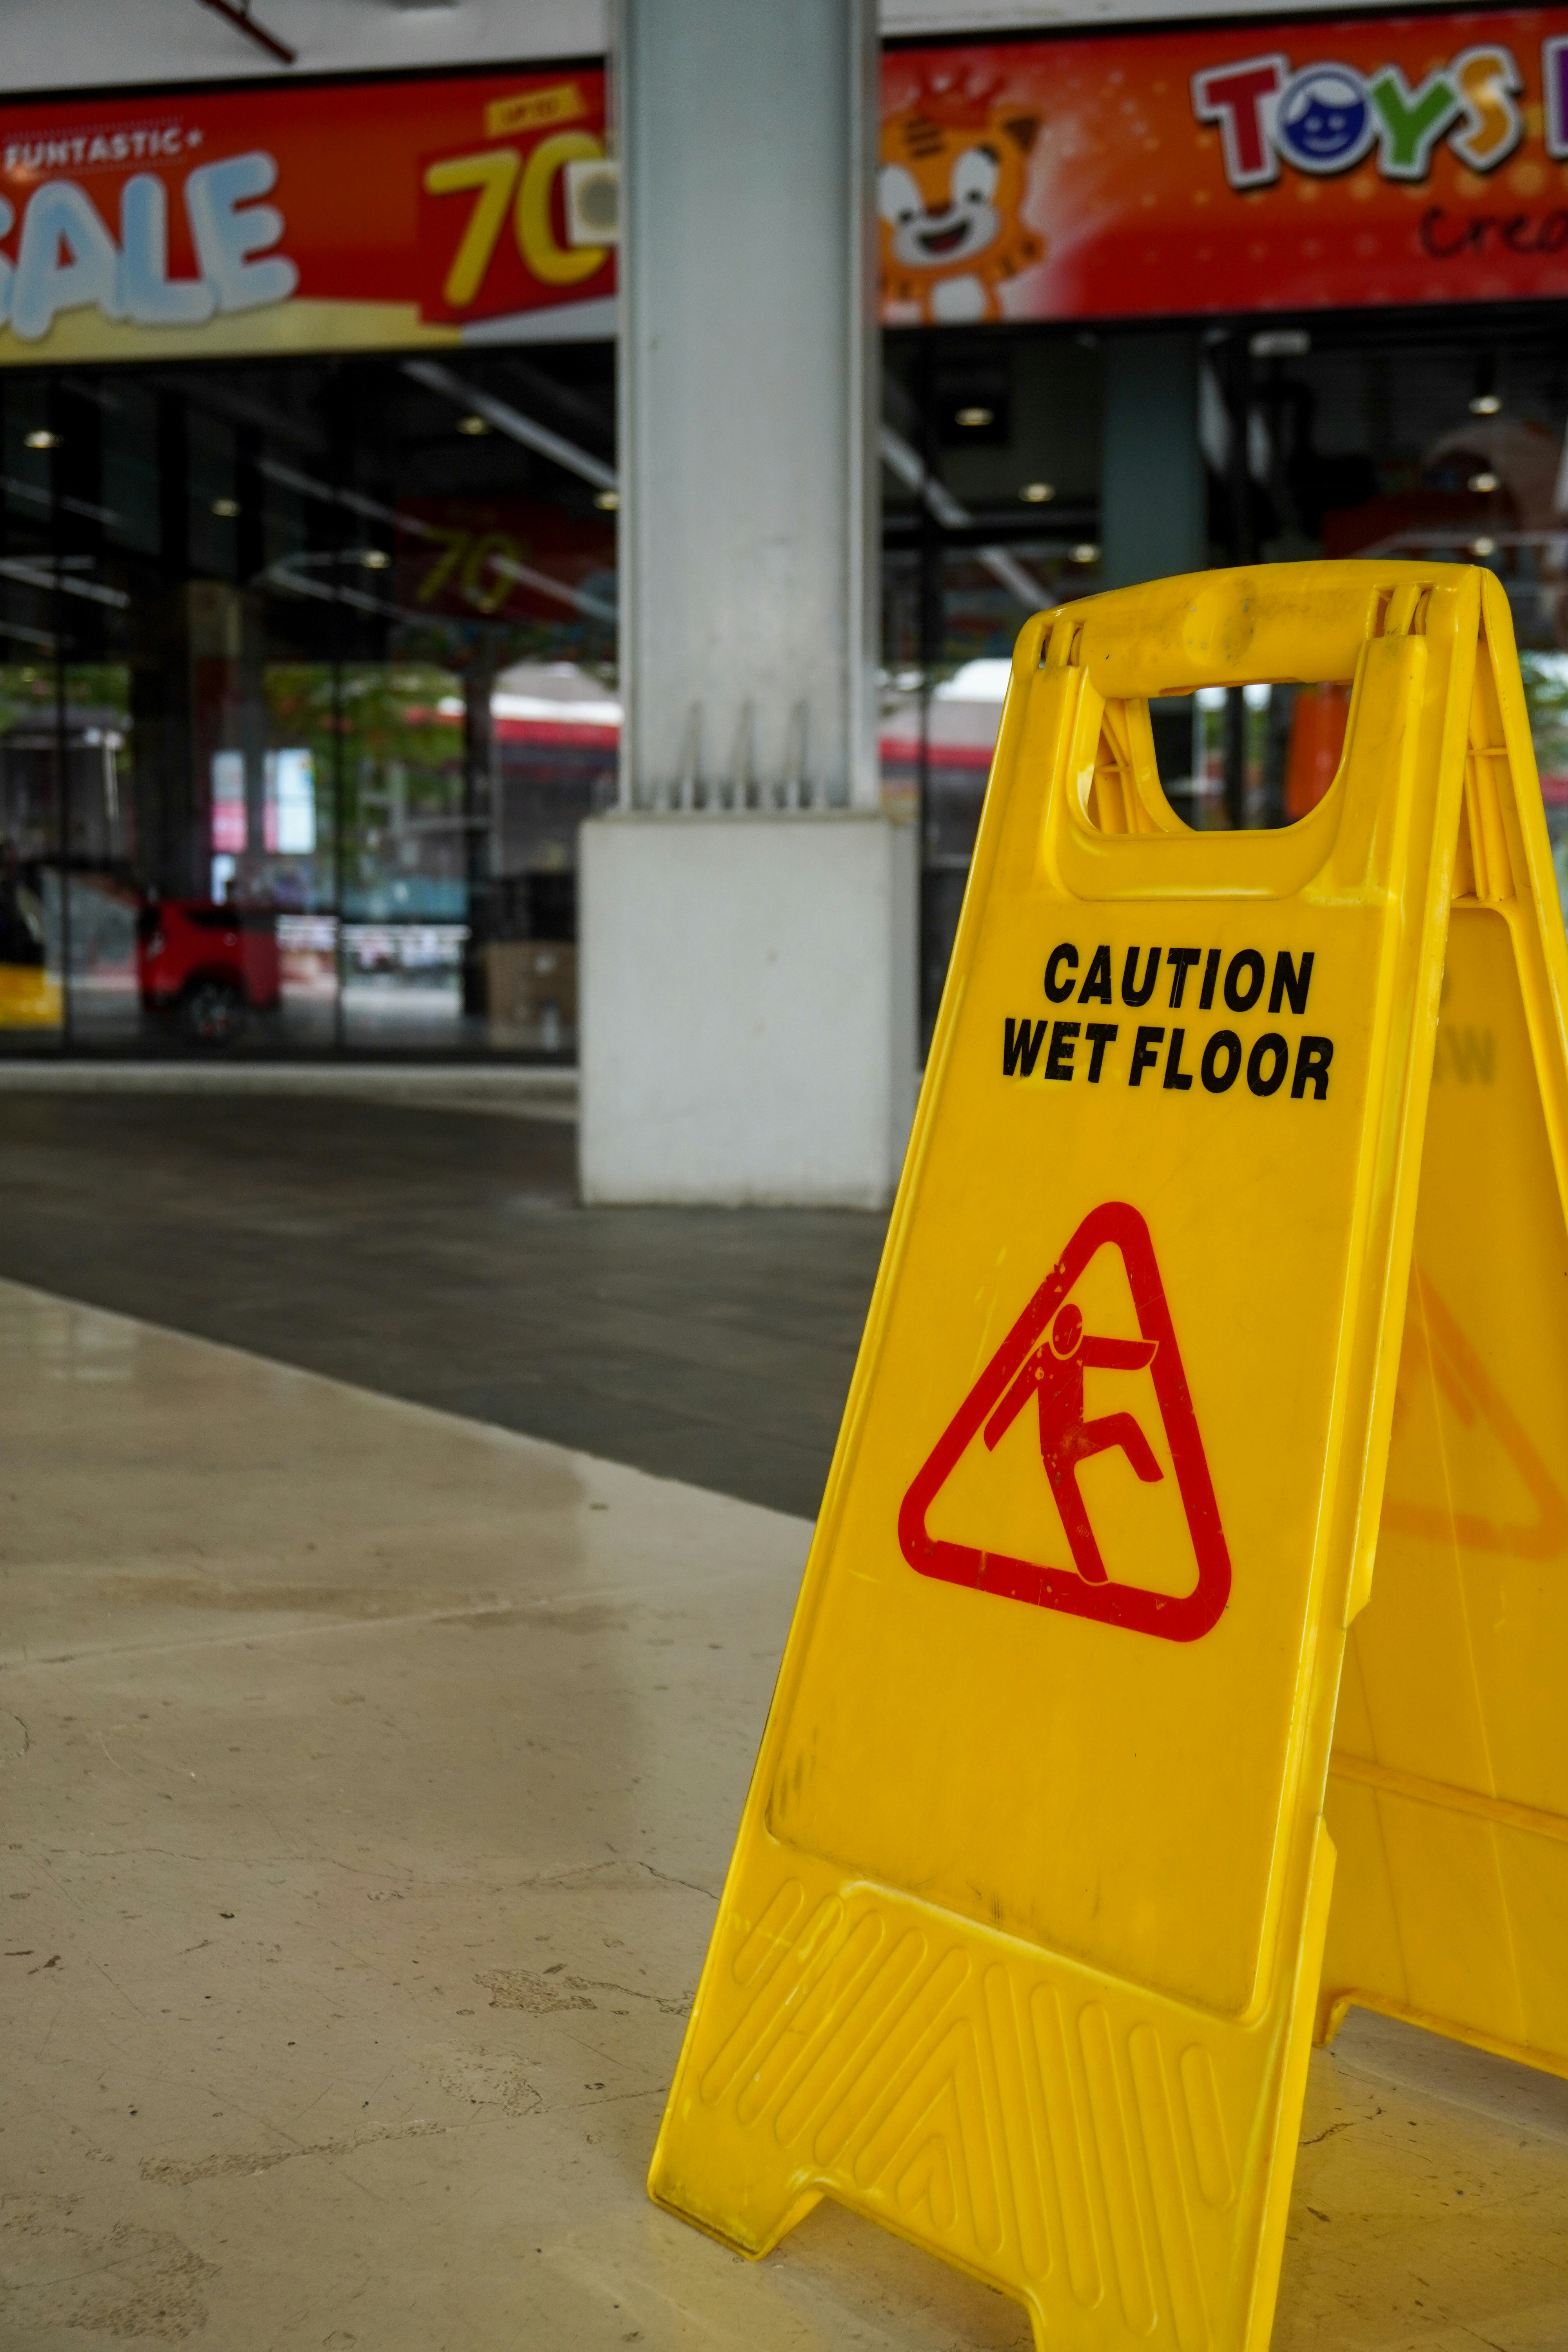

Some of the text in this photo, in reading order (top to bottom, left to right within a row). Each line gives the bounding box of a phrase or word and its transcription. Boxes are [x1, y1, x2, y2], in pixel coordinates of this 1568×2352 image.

[1191, 43, 1523, 187] TOYS
[0, 149, 300, 342] ALE
[1044, 942, 1315, 1014] CAUTION
[1003, 1017, 1334, 1100] WET FLOOR
